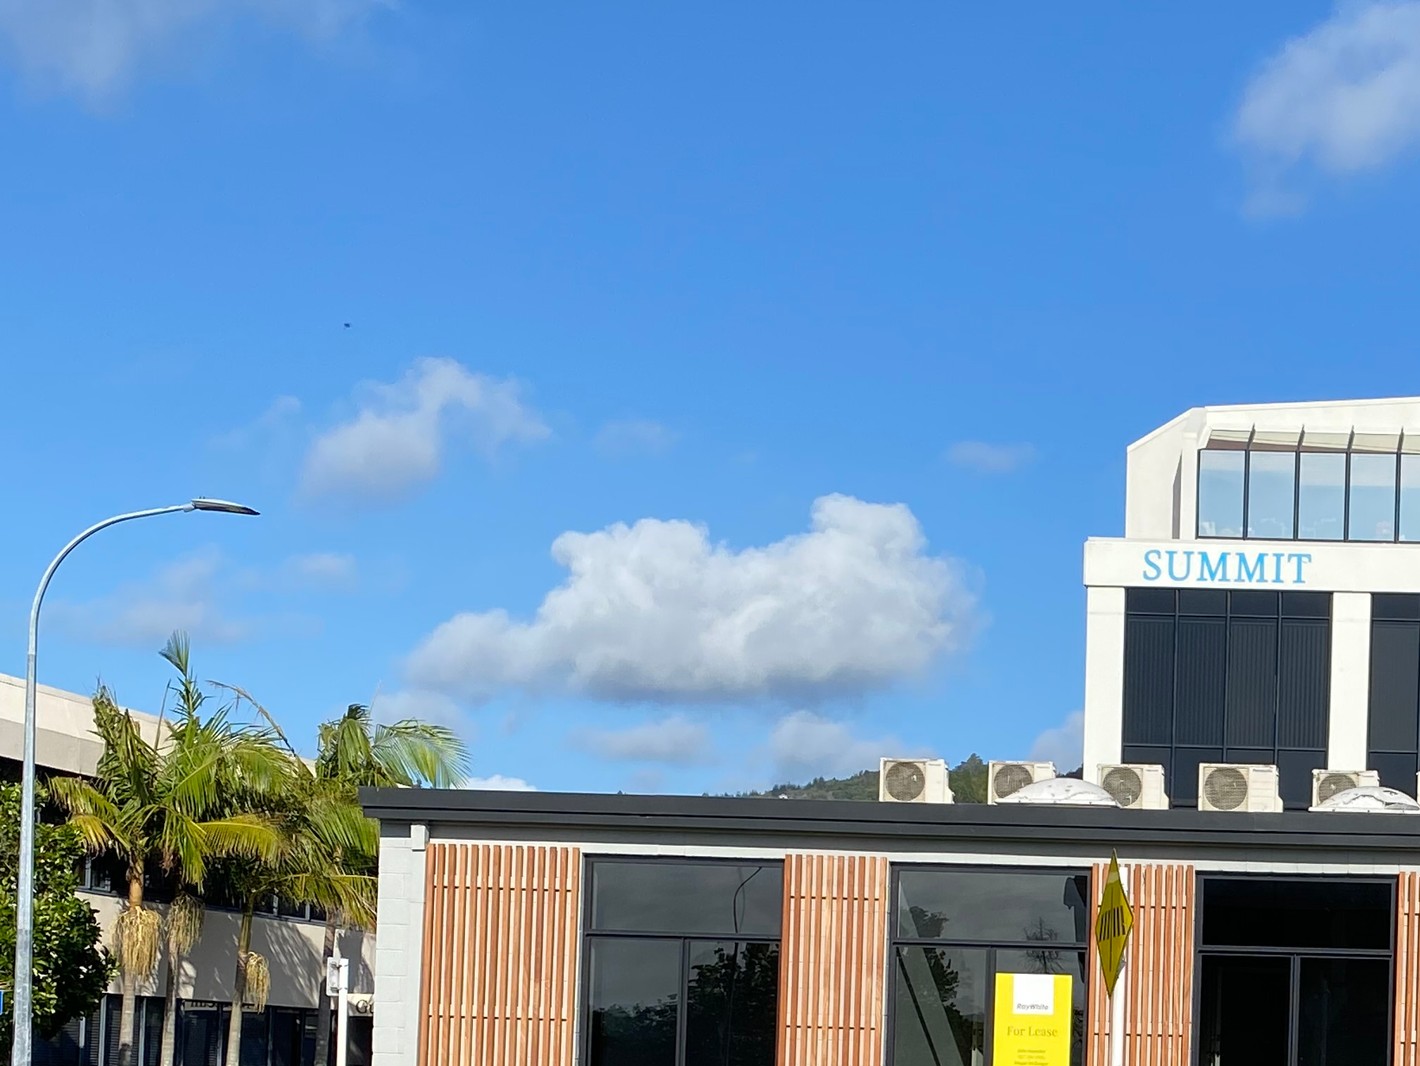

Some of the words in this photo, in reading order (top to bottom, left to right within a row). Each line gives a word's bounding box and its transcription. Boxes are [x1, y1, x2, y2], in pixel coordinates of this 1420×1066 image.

[1142, 549, 1312, 584] SUMMIT
[1007, 1026, 1025, 1036] For
[1028, 1026, 1058, 1037] Lease
